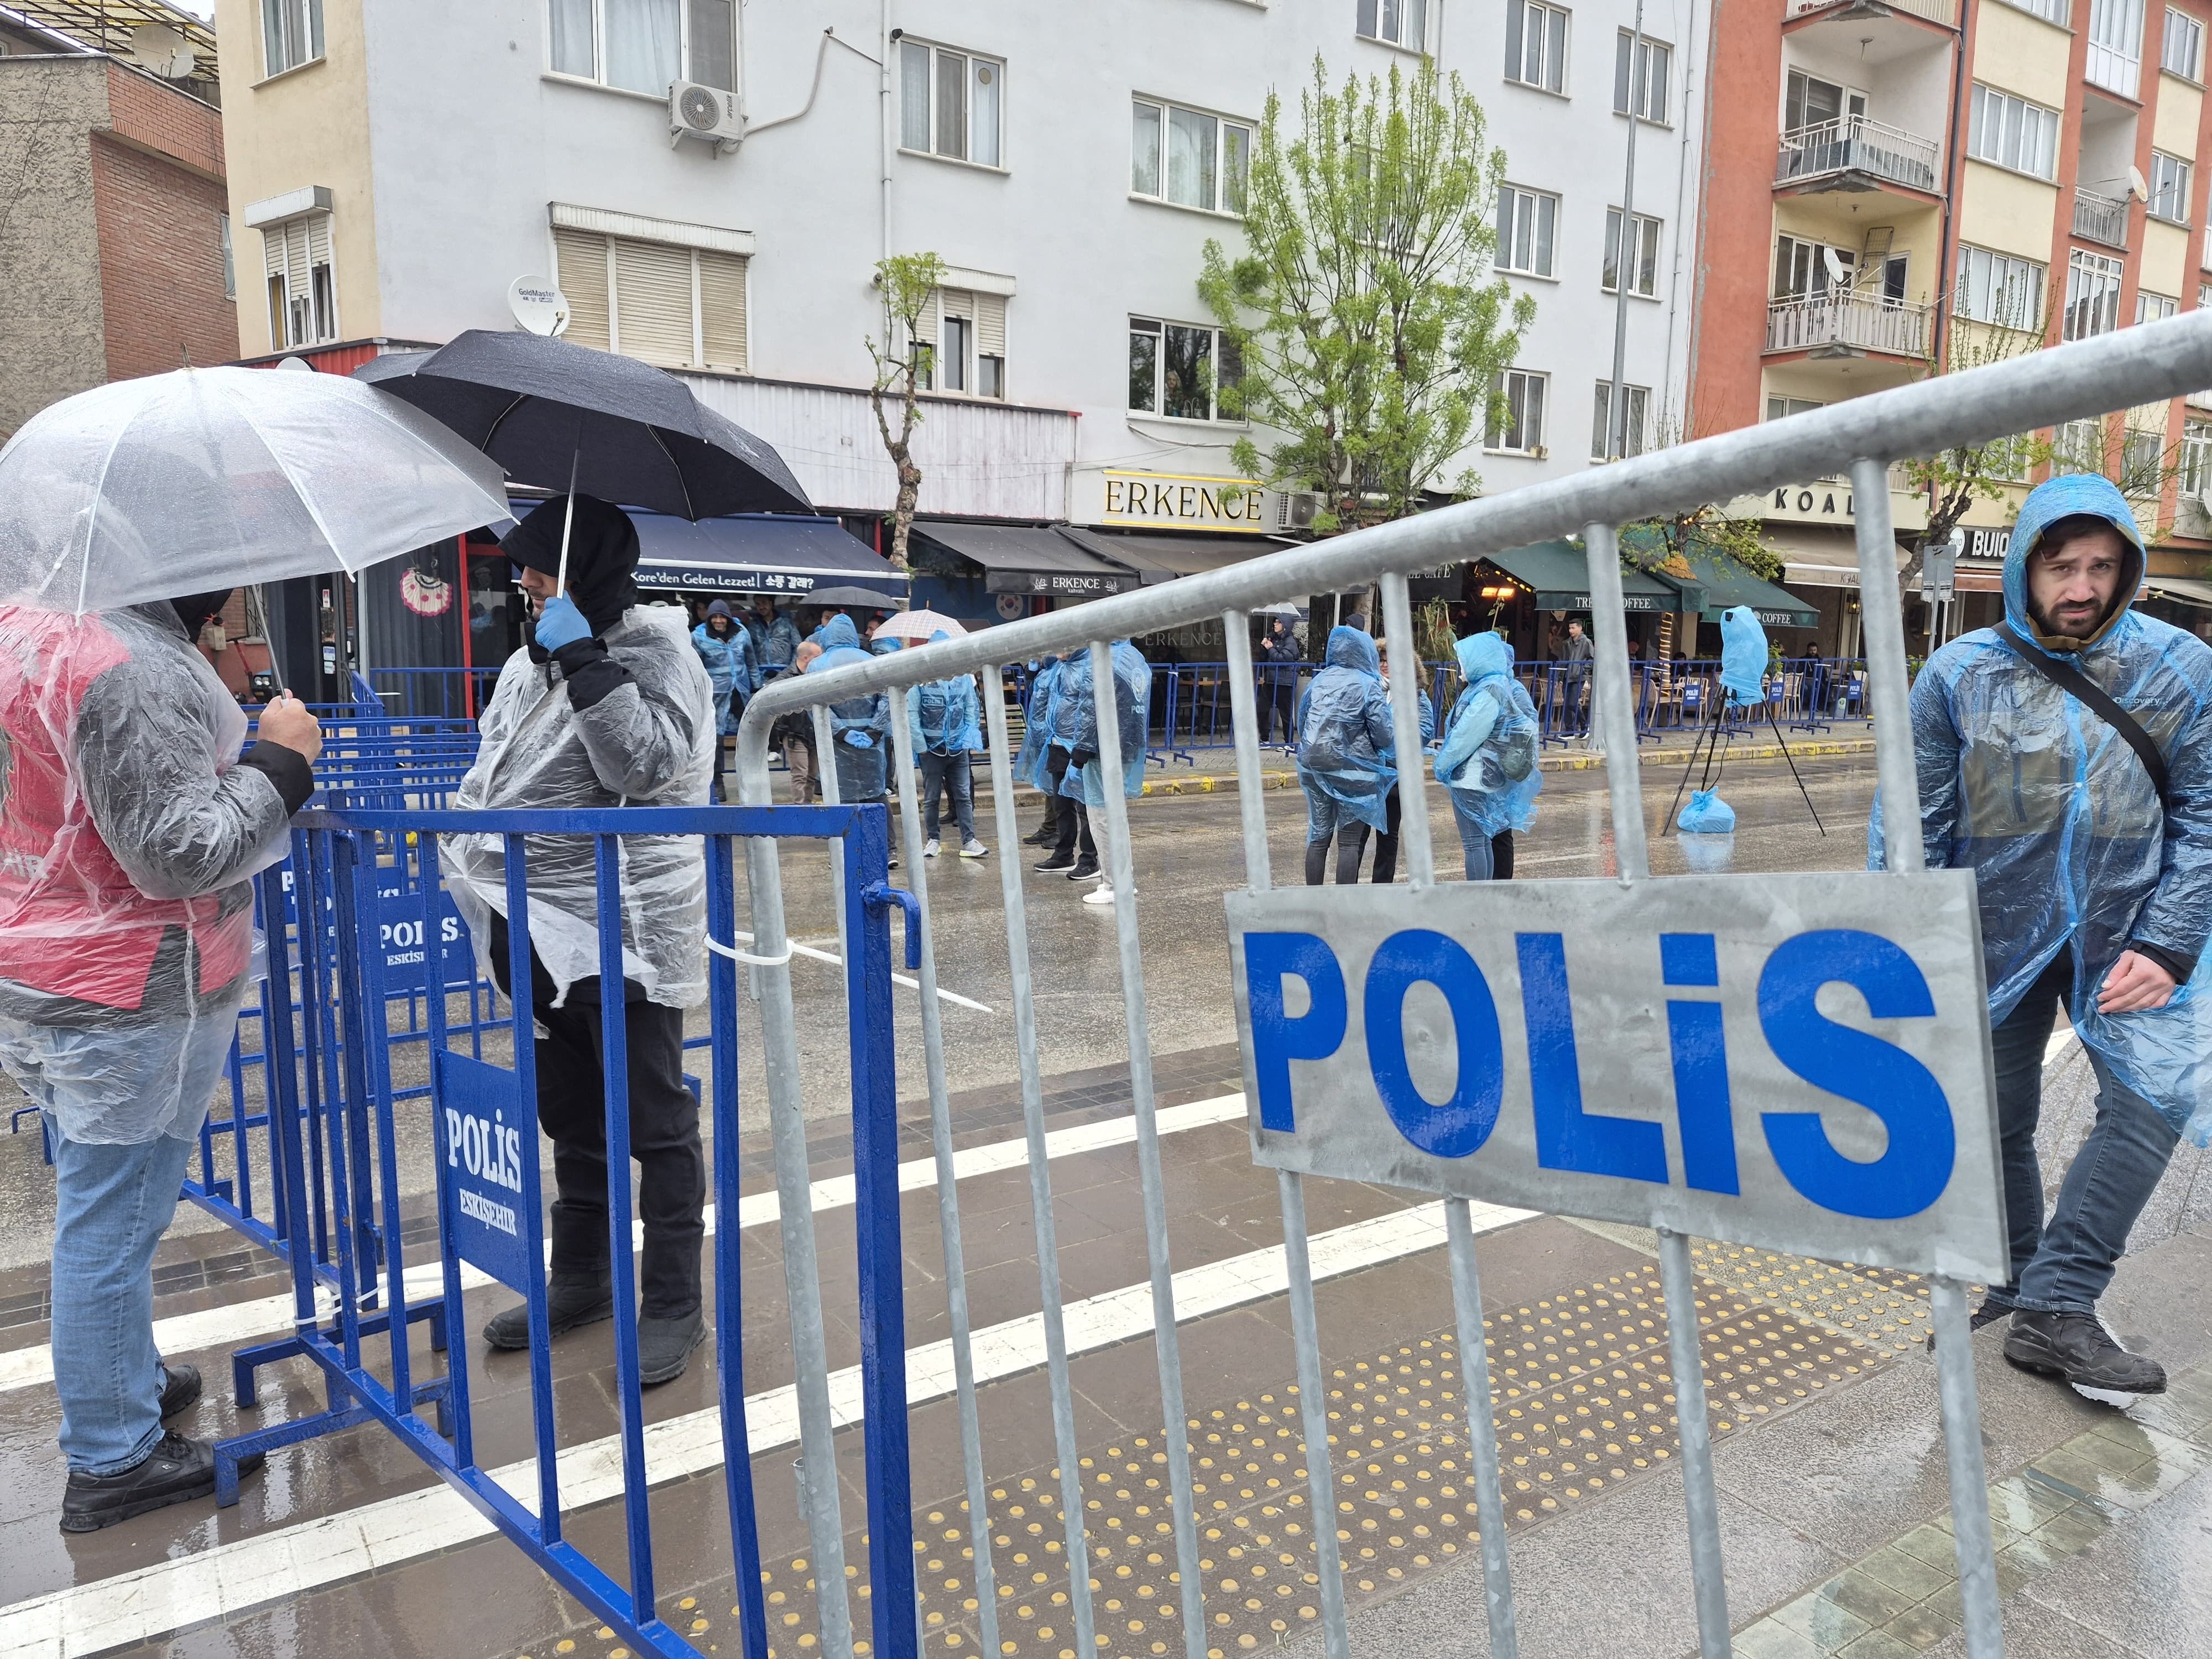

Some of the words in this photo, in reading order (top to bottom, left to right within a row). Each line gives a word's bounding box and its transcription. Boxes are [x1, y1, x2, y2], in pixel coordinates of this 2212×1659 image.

[726, 93, 734, 119] arçelik
[518, 288, 555, 297] GoldMaster
[1105, 480, 1264, 521] ERKENCE
[1775, 488, 1855, 515] KOAL
[630, 571, 680, 583] Kore'den
[682, 573, 716, 586] Gelen
[718, 575, 755, 587] Lezzet!
[1052, 577, 1100, 589] ERKENCE
[1840, 573, 1859, 585] KOAL
[1575, 597, 1593, 608] TRE
[1623, 597, 1651, 609] OFFEE
[1762, 613, 1791, 624] COFFEE
[2114, 697, 2160, 705] Discovery
[380, 916, 458, 950] POLS
[387, 945, 448, 967] ESKİŞR
[1243, 927, 1957, 1219] POLİS
[445, 1107, 522, 1194] POLİS
[459, 1188, 518, 1237] ESKİŞEHİR
